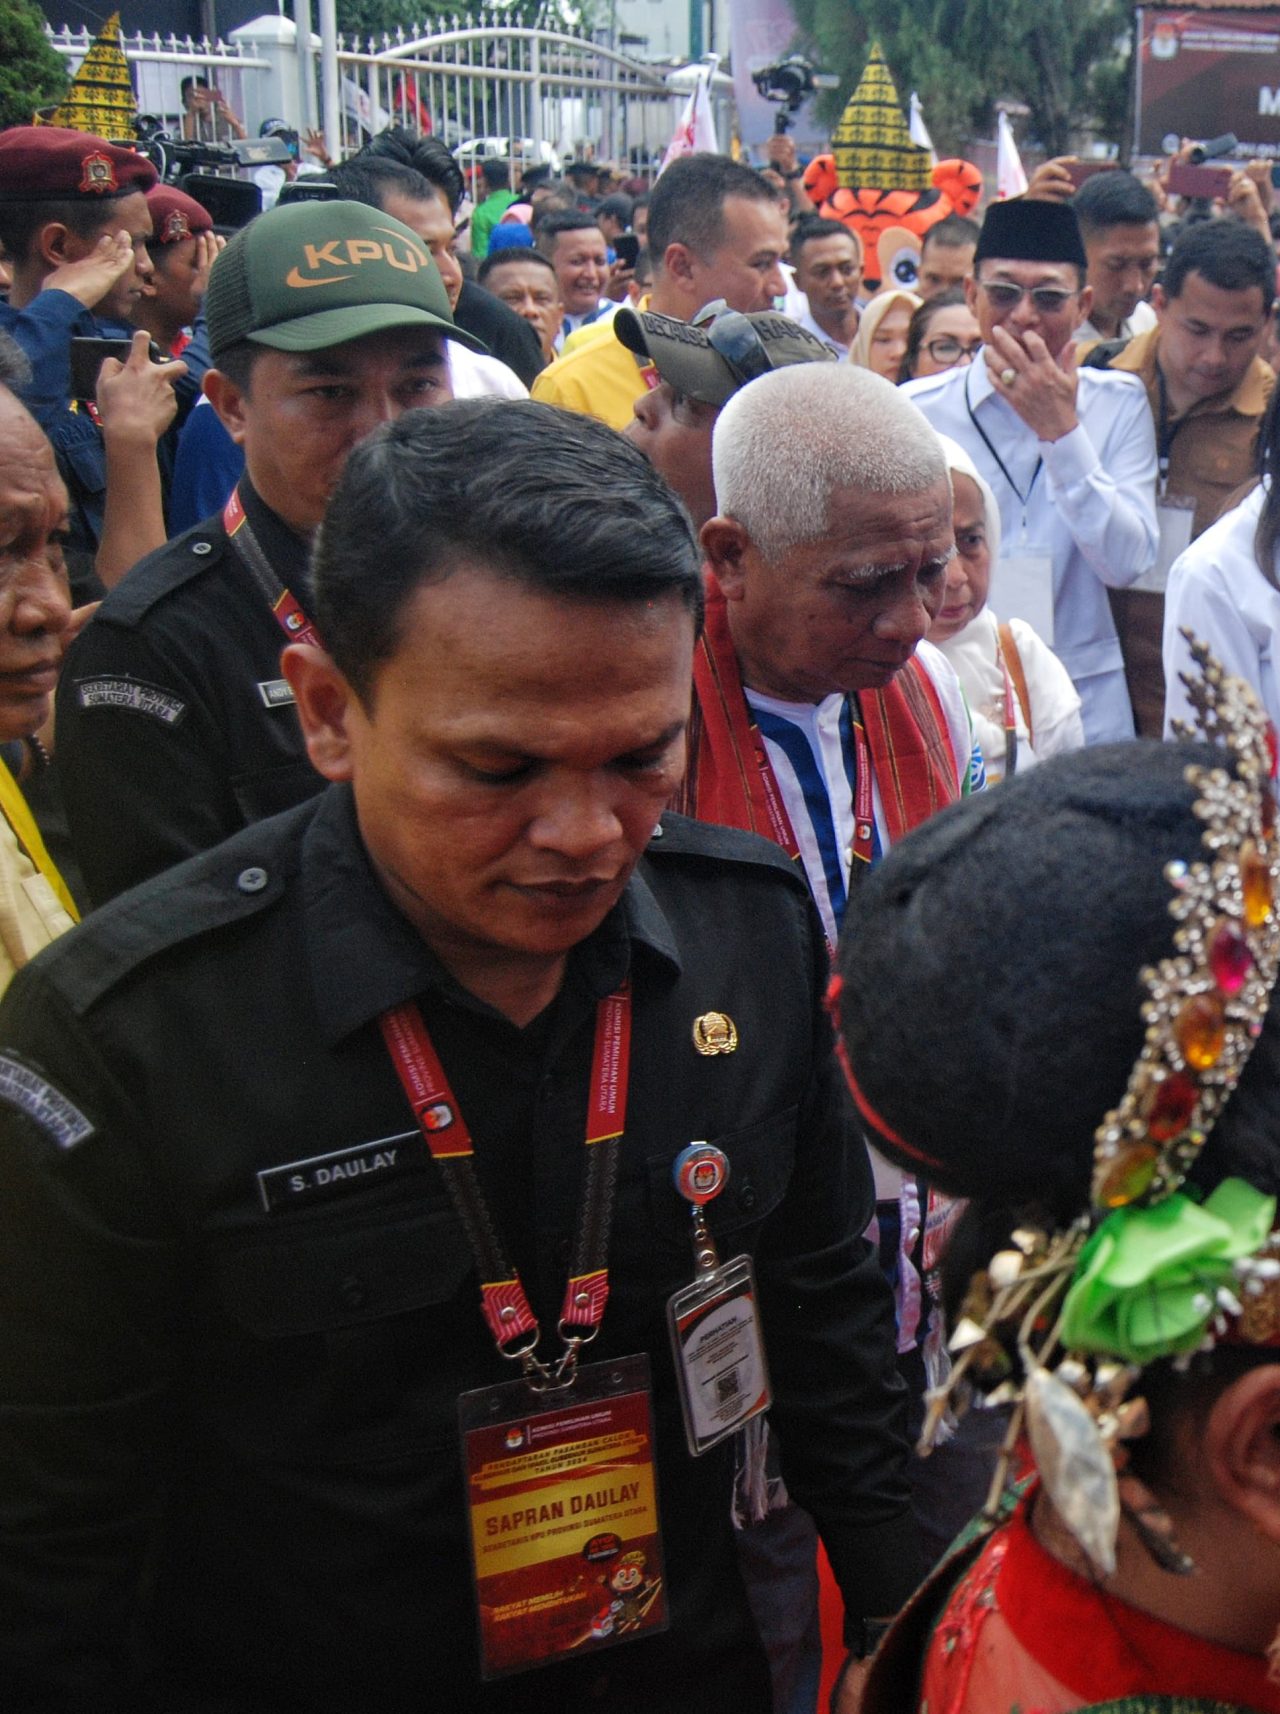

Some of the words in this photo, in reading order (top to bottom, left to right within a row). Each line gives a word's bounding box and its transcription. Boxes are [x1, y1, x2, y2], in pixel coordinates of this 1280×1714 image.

[304, 239, 418, 273] KPU
[610, 1035, 621, 1081] PEMILIHAN
[408, 1064, 427, 1098] KOMISI
[607, 1085, 617, 1114] UMUM
[290, 1174, 312, 1192] S.
[315, 1149, 398, 1186] DAULAY
[485, 1502, 564, 1534] SAPRAN
[569, 1483, 641, 1513] DAULAY
